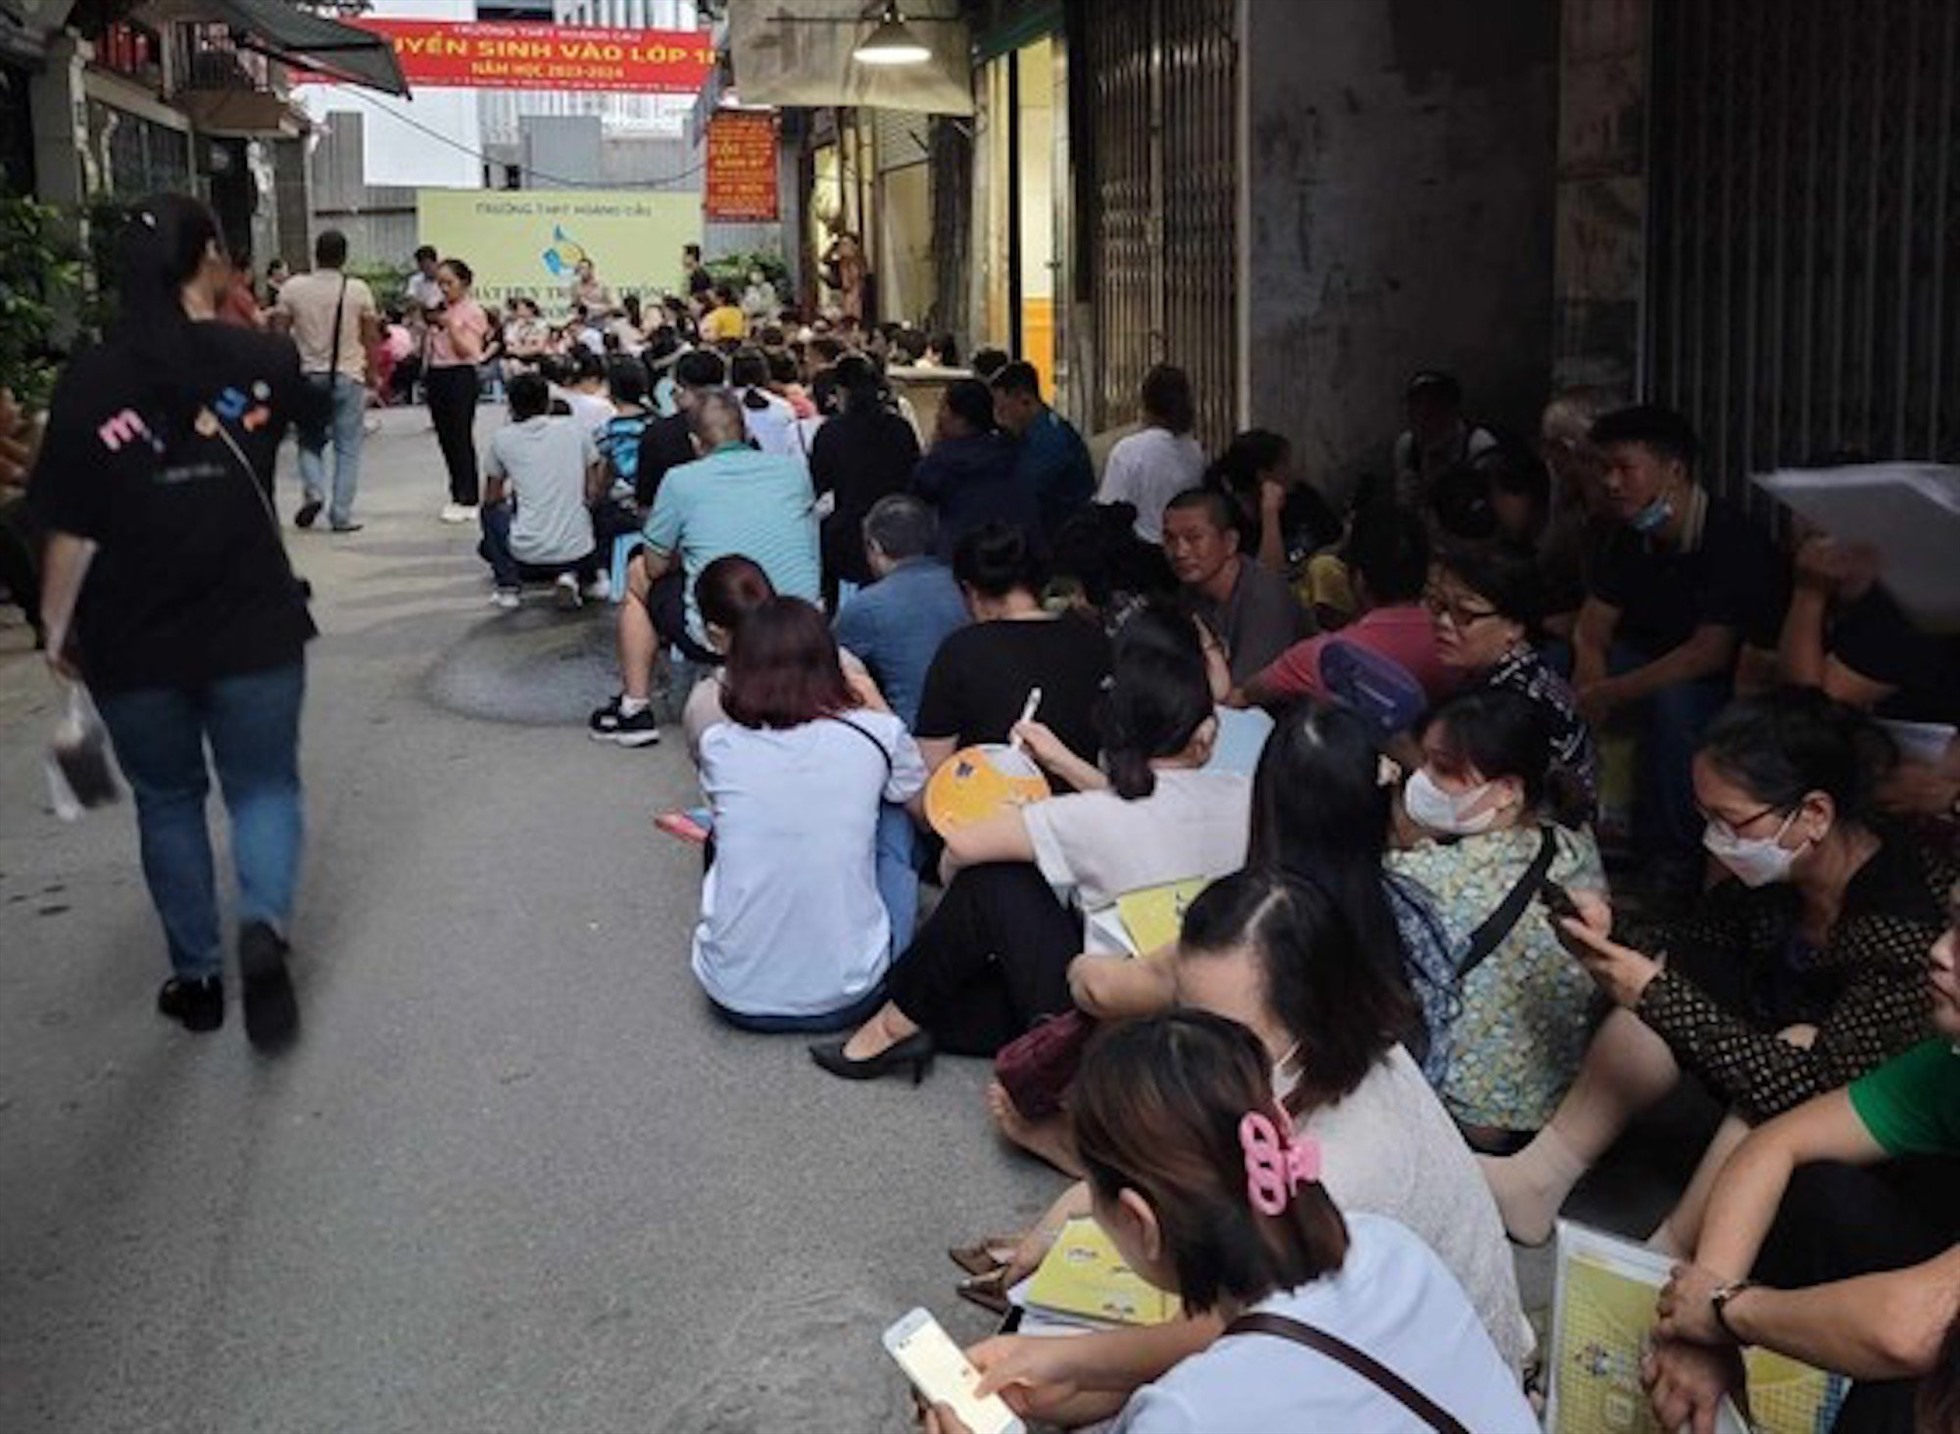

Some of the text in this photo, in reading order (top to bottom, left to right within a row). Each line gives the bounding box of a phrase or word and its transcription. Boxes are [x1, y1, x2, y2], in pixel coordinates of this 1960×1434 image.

[477, 39, 552, 58] SINH
[559, 41, 623, 61] VÀO
[631, 43, 687, 64] LỚP
